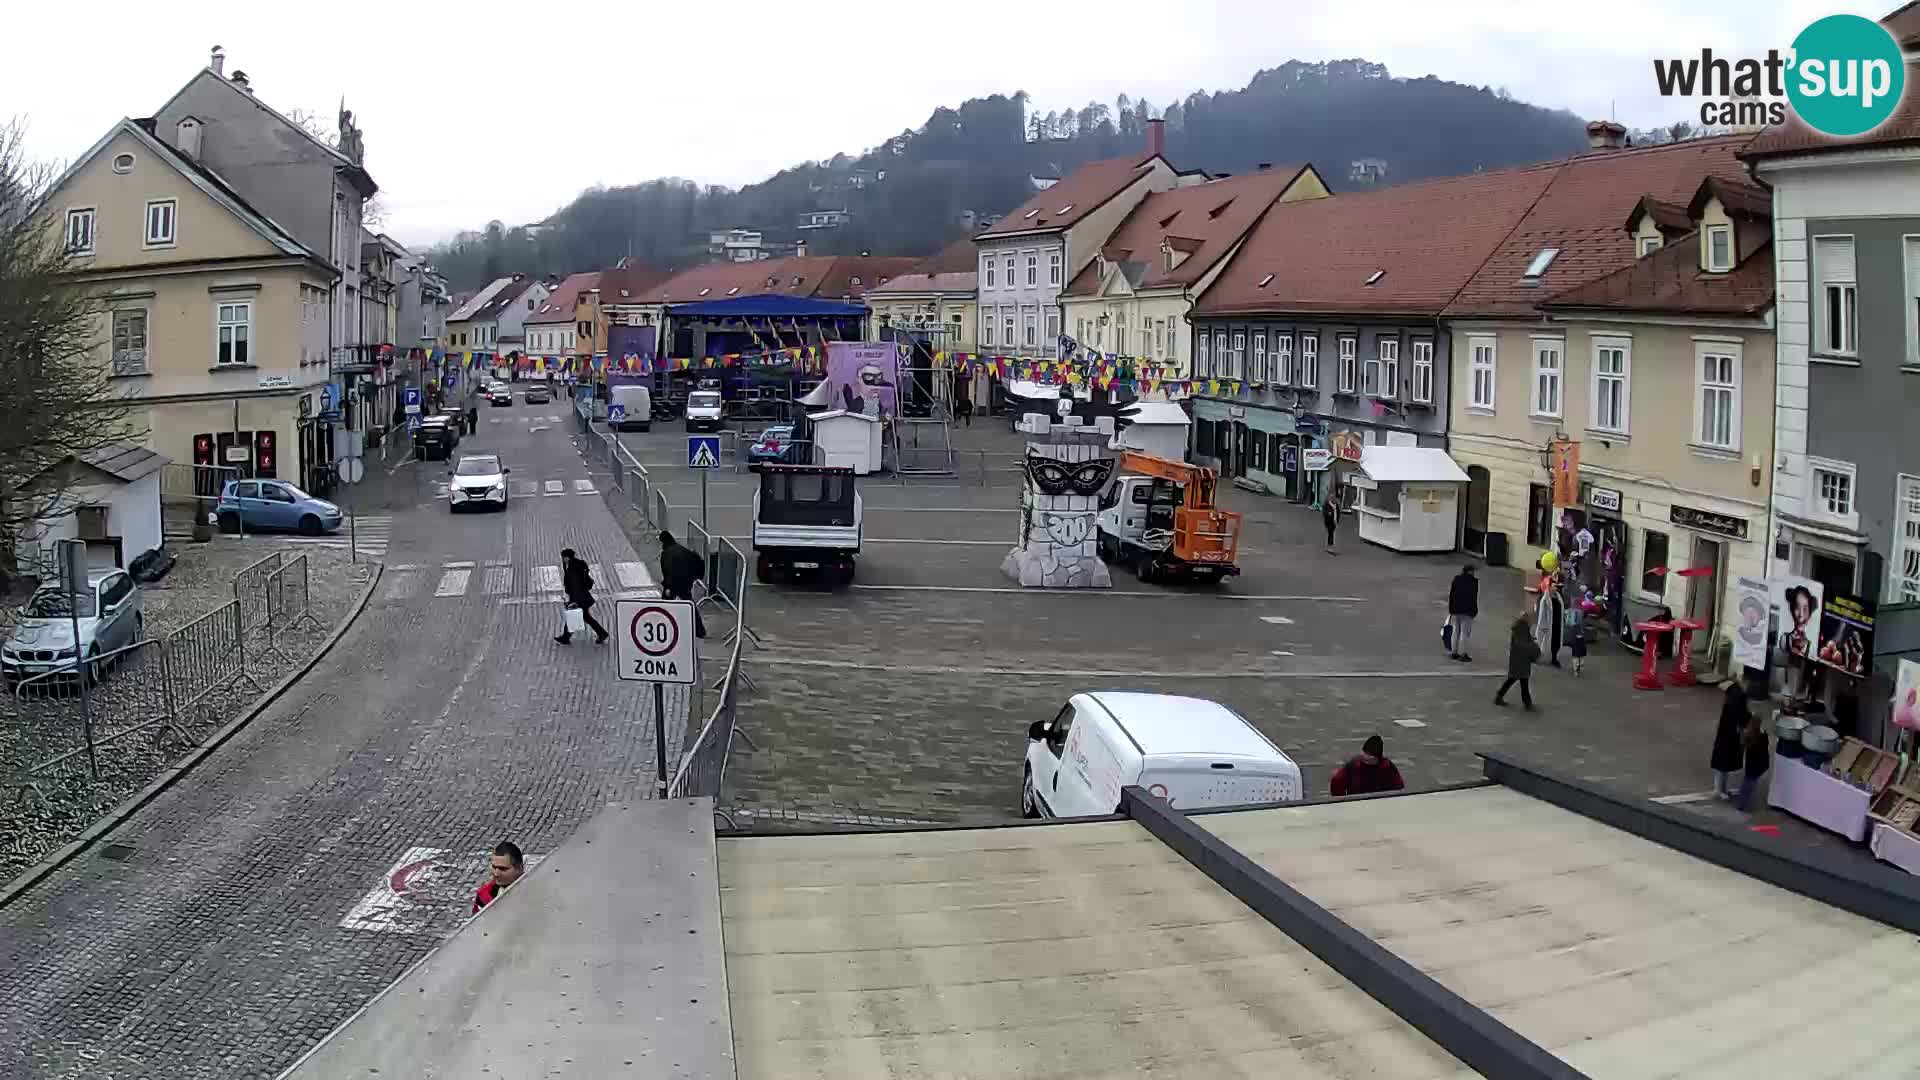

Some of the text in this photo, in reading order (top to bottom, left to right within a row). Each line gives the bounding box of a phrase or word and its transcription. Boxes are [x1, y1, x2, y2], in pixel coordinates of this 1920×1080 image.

[1048, 516, 1087, 545] 200
[643, 622, 667, 643] 30
[634, 660, 678, 676] ZONA
